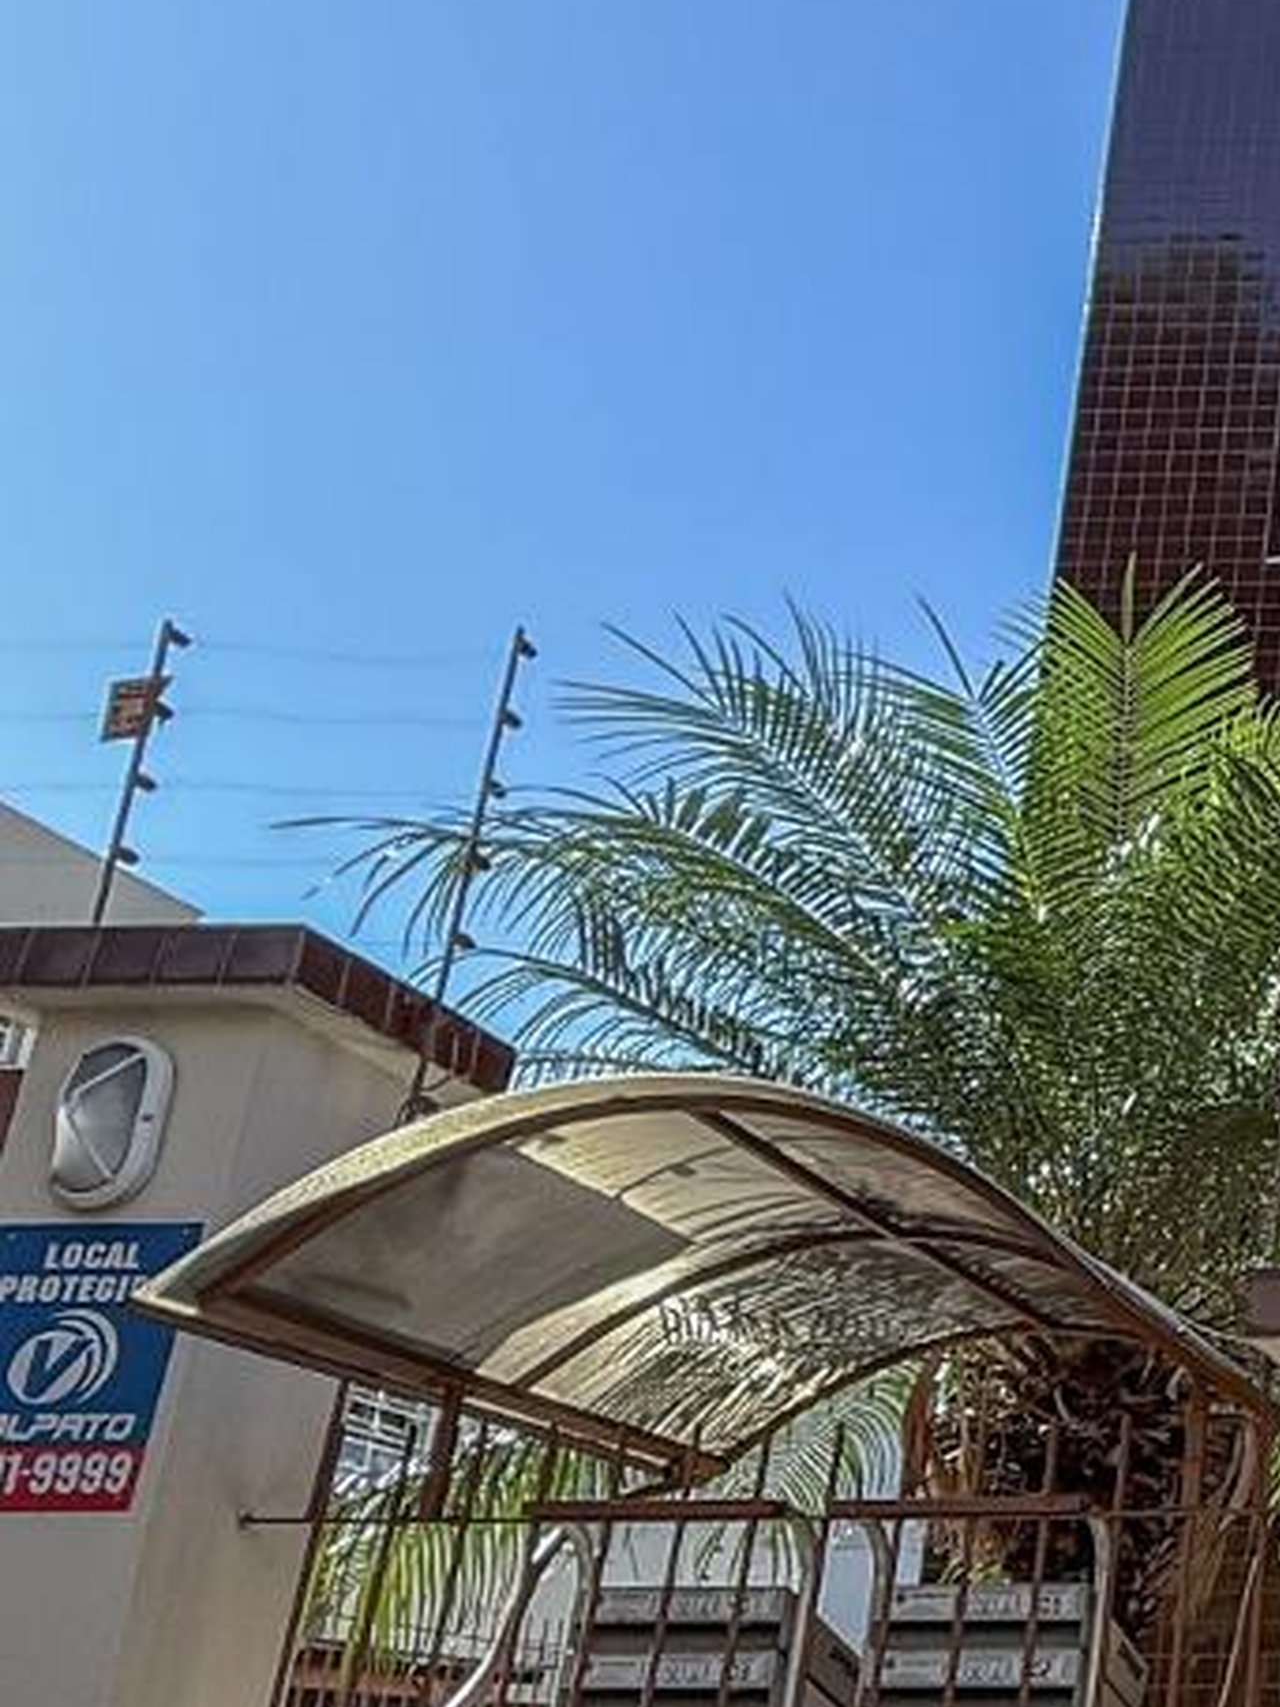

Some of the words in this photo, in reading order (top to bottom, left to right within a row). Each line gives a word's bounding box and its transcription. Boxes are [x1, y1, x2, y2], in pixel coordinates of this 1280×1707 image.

[44, 1242, 140, 1270] LOCAL
[0, 1274, 148, 1303] PROTEGI
[0, 1413, 137, 1441] LPATO
